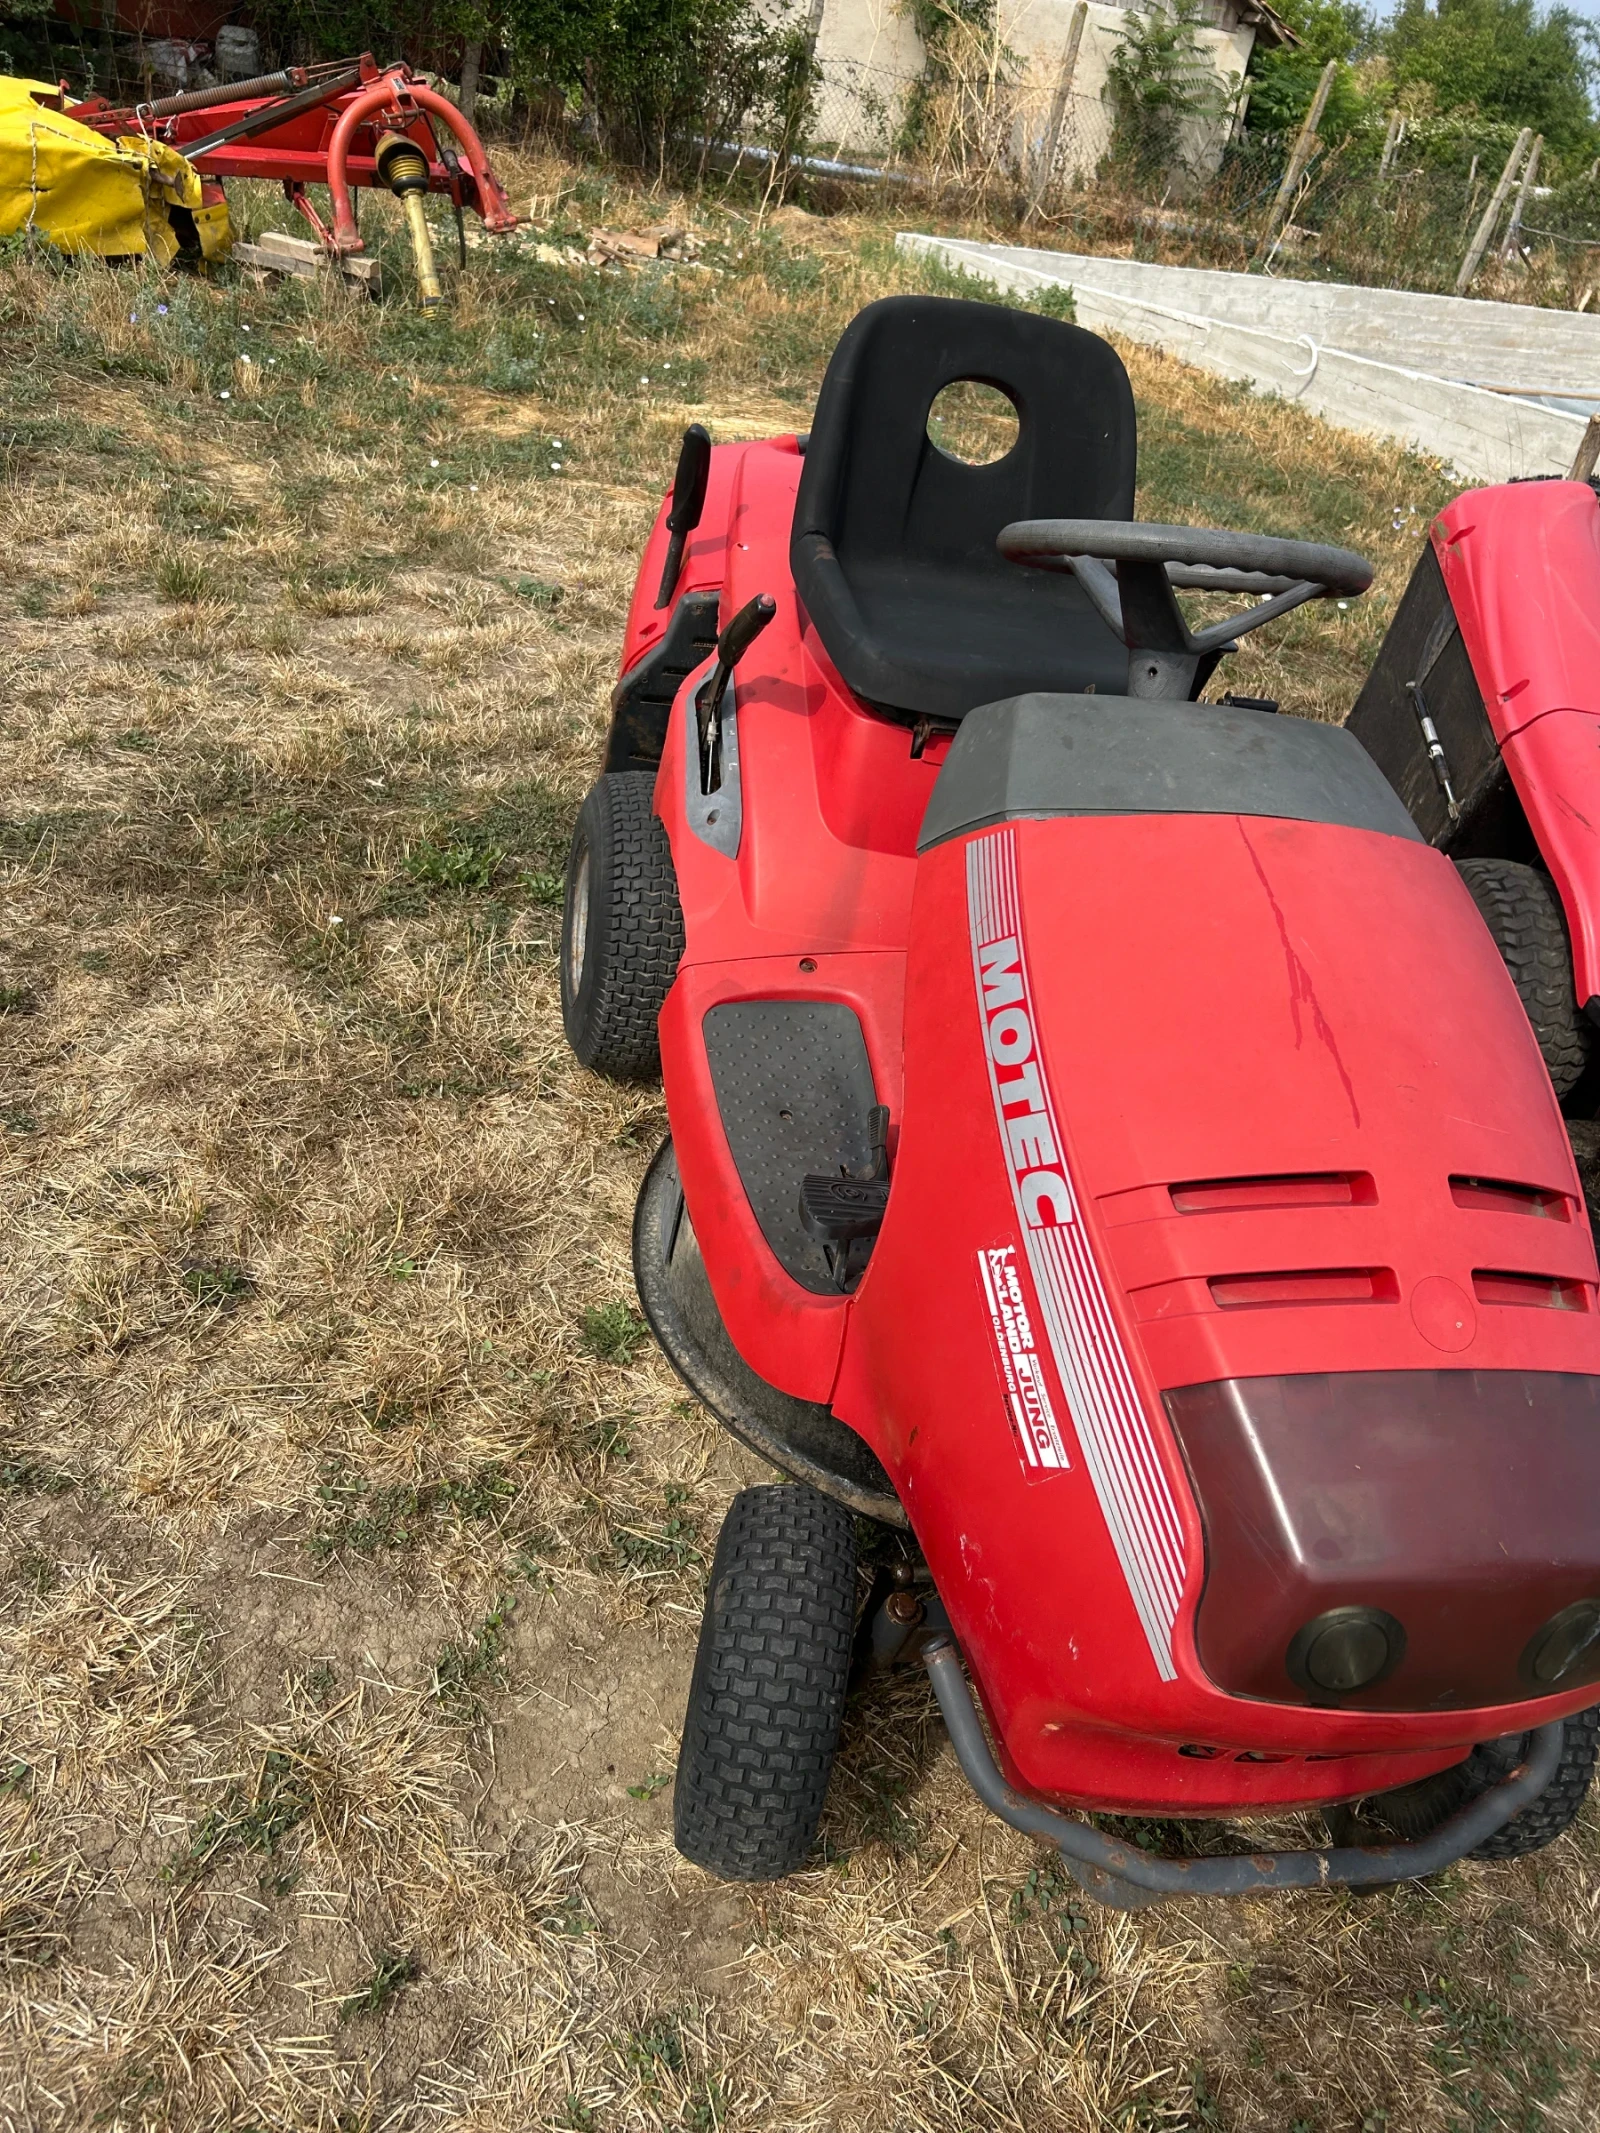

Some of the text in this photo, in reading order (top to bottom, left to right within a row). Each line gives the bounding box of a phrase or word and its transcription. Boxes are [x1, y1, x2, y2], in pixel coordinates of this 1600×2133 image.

[978, 935, 1073, 1228] MOTEC
[998, 1291, 1022, 1354] LAND
[1004, 1266, 1035, 1350] MOTOR
[992, 1316, 1017, 1392] OLDENBURG
[1018, 1367, 1051, 1449] JUNG
[1041, 1393, 1052, 1419] Service
[1050, 1424, 1065, 1461] Ersatzteile
